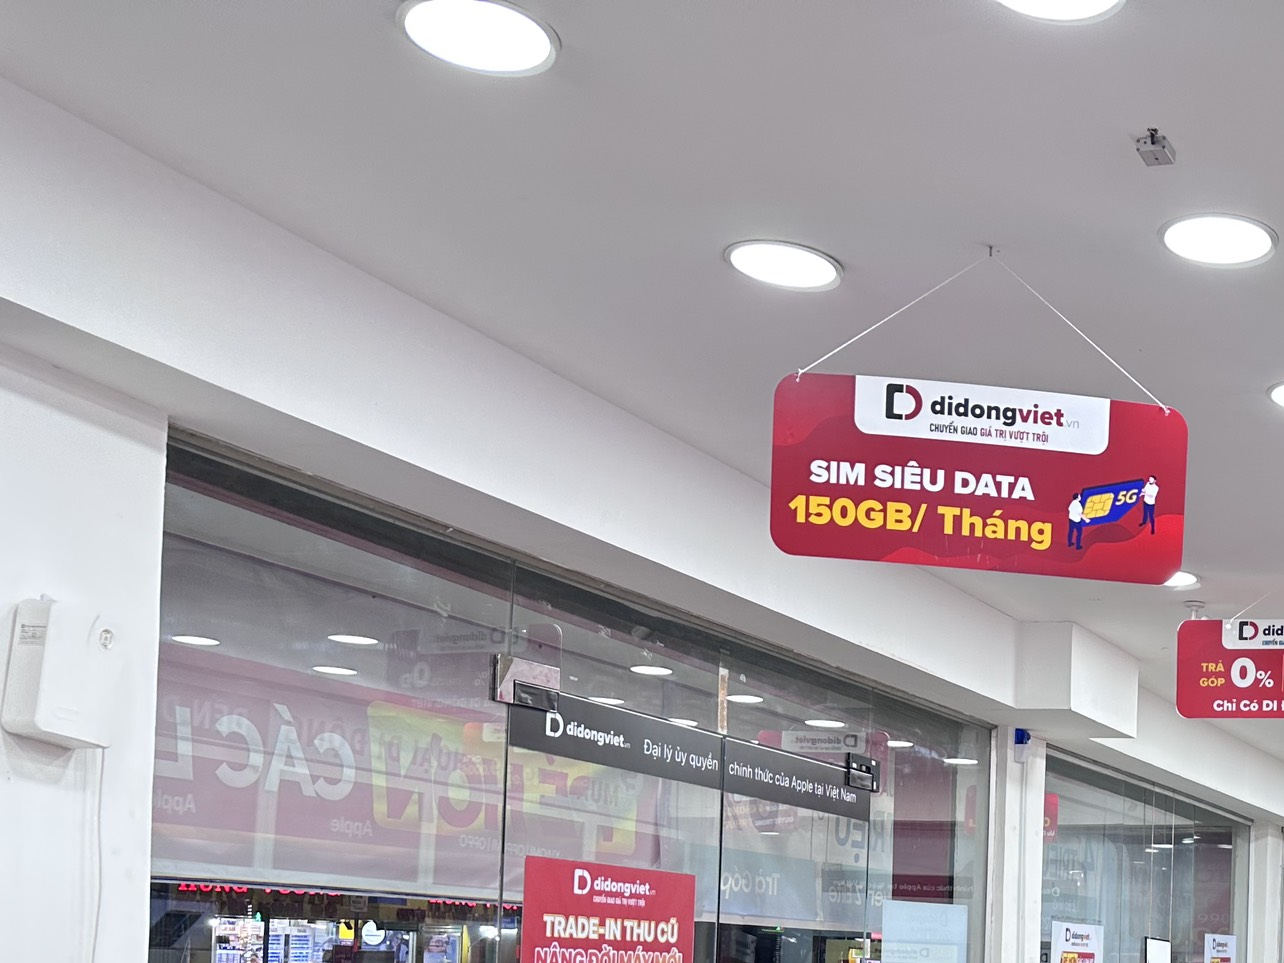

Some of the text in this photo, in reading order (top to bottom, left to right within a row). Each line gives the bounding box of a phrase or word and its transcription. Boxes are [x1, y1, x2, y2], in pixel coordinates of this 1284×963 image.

[809, 459, 1035, 500] SIM SIÊU DATA
[1115, 488, 1138, 506] 5G
[789, 494, 1052, 550] 150GB/ Tháng
[1200, 677, 1225, 688] GÓP
[1201, 660, 1224, 673] TRẢ
[1231, 657, 1274, 688] 0%
[1213, 699, 1236, 712] Chỉ
[1240, 700, 1258, 712] Có
[1263, 700, 1278, 712] DI
[644, 739, 661, 757] Đại
[663, 743, 672, 761] lý
[675, 743, 687, 764] ủy
[689, 751, 718, 771] quyền
[729, 760, 752, 779] chính
[754, 765, 773, 784] thức
[775, 770, 790, 788] của
[791, 775, 813, 795] Apple
[814, 778, 824, 798] tại
[826, 782, 839, 800] Việt
[841, 790, 857, 803] Nam
[543, 914, 678, 944] TRADE-IN THU CŨ
